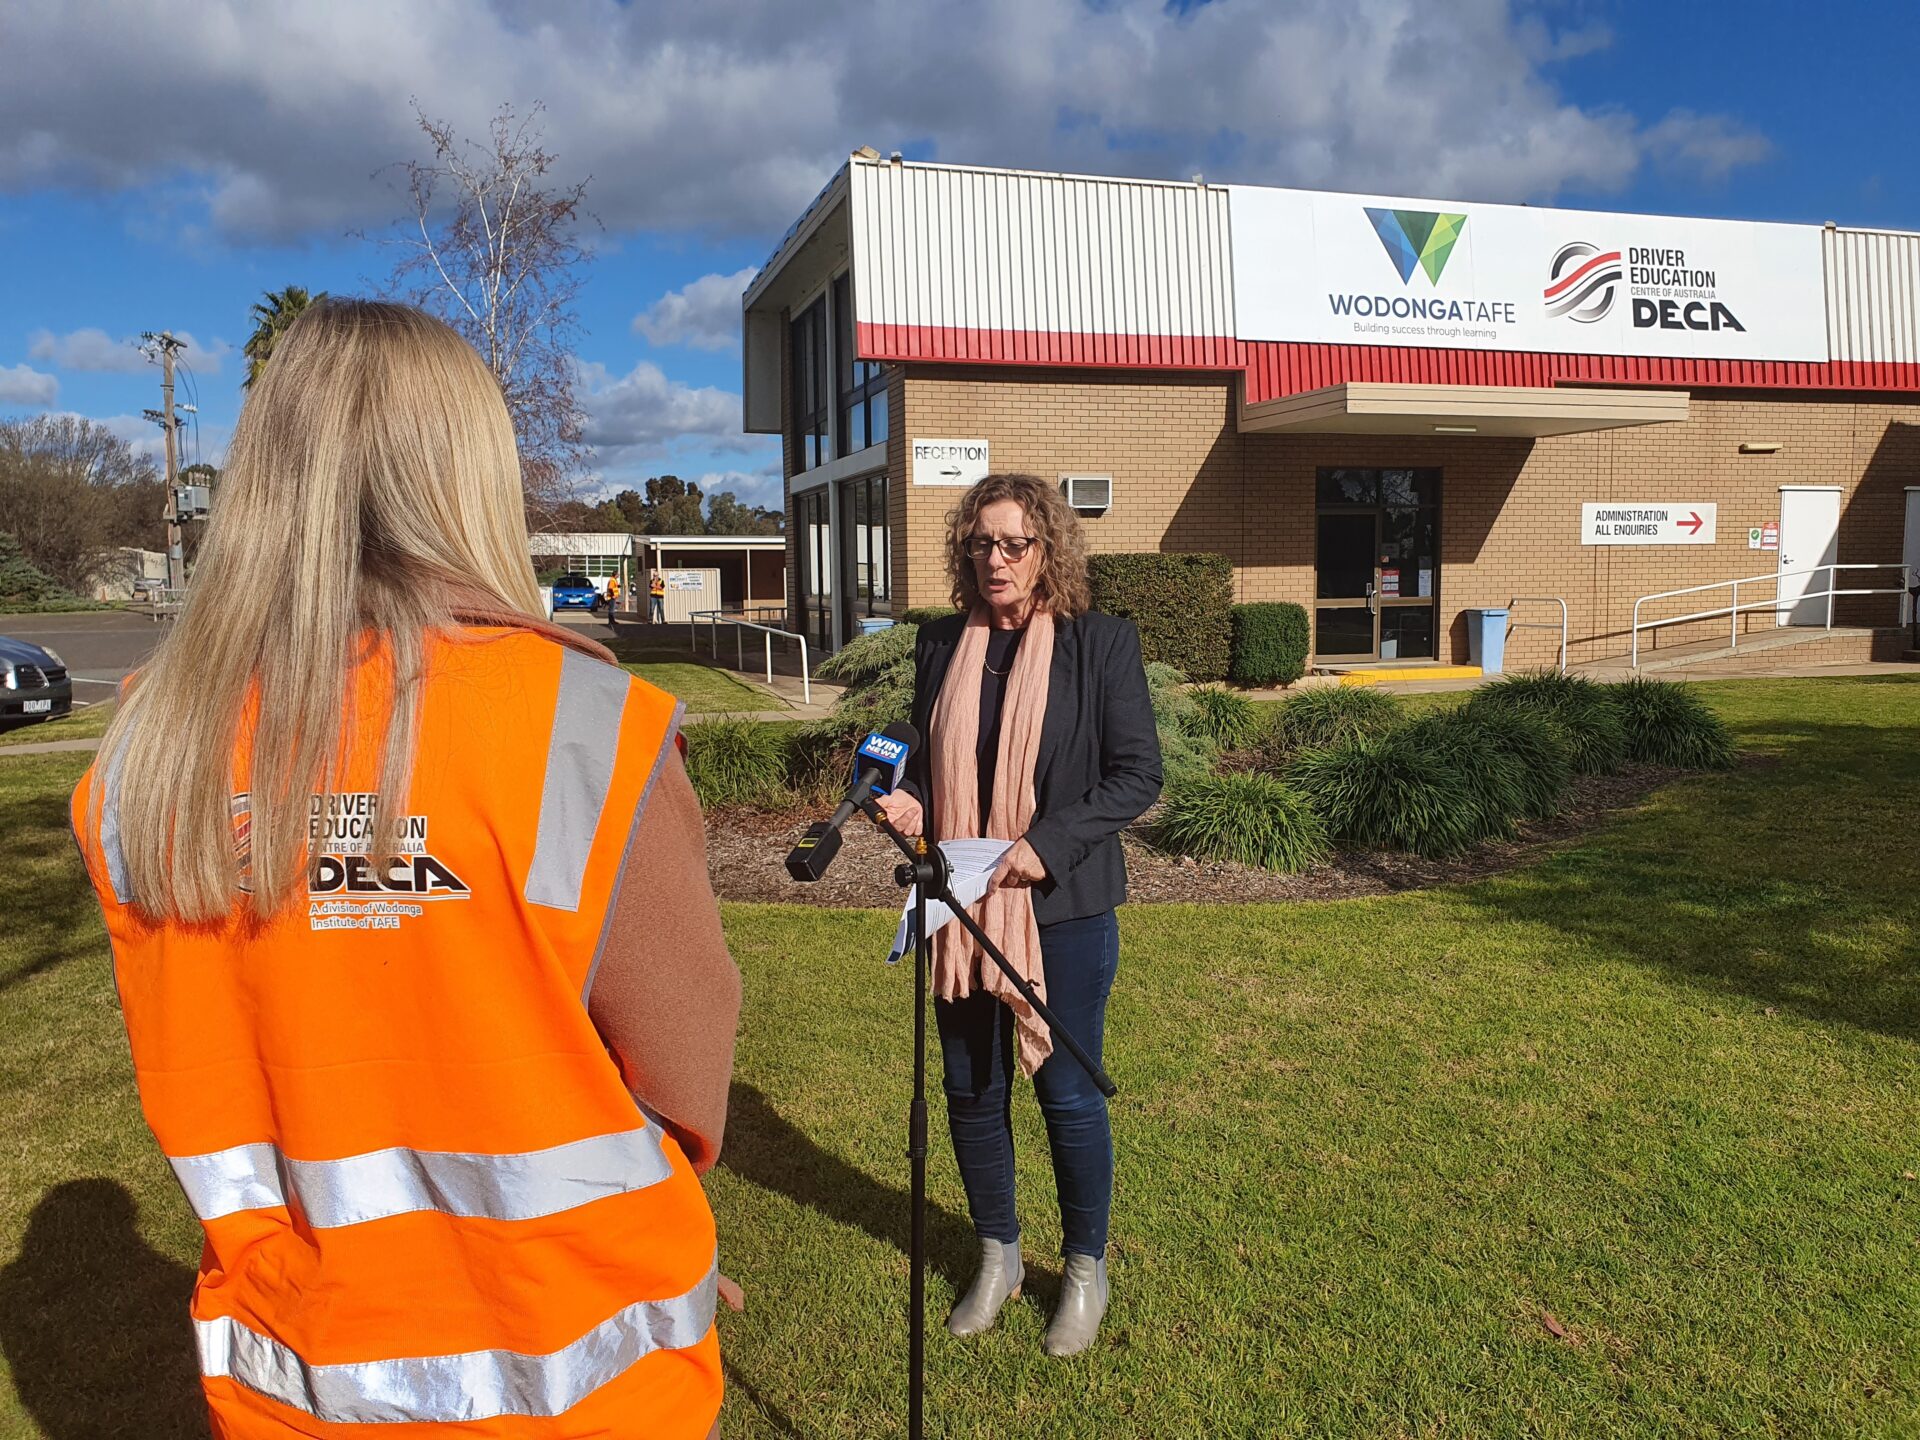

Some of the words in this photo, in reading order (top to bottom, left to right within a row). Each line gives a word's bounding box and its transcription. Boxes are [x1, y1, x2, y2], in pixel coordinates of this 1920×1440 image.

[1629, 247, 1685, 267] DRIVER
[1630, 267, 1716, 288] EDUCATION
[1630, 286, 1661, 297] CENTRE
[1662, 288, 1672, 297] OF
[1673, 288, 1717, 299] AUSTRALIA
[1632, 298, 1747, 332] DECA
[1353, 322, 1390, 335] Building
[1391, 325, 1425, 336] success
[1427, 326, 1462, 339] through
[1462, 327, 1497, 340] learning
[915, 446, 987, 460] RECEPTION
[1595, 510, 1668, 521] ADMINISTRATION
[1595, 524, 1611, 535] ALL
[1614, 524, 1658, 536] ENQUIRIES
[865, 744, 898, 759] NEWS
[870, 735, 903, 754] WIN
[349, 842, 363, 853] OF
[309, 856, 471, 892] DECA
[311, 904, 319, 914] A
[322, 903, 361, 914] division
[363, 903, 373, 914] of
[375, 903, 422, 916] Wodonga
[312, 918, 357, 929] Institute
[358, 917, 369, 928] of
[371, 917, 398, 928] TAFE
